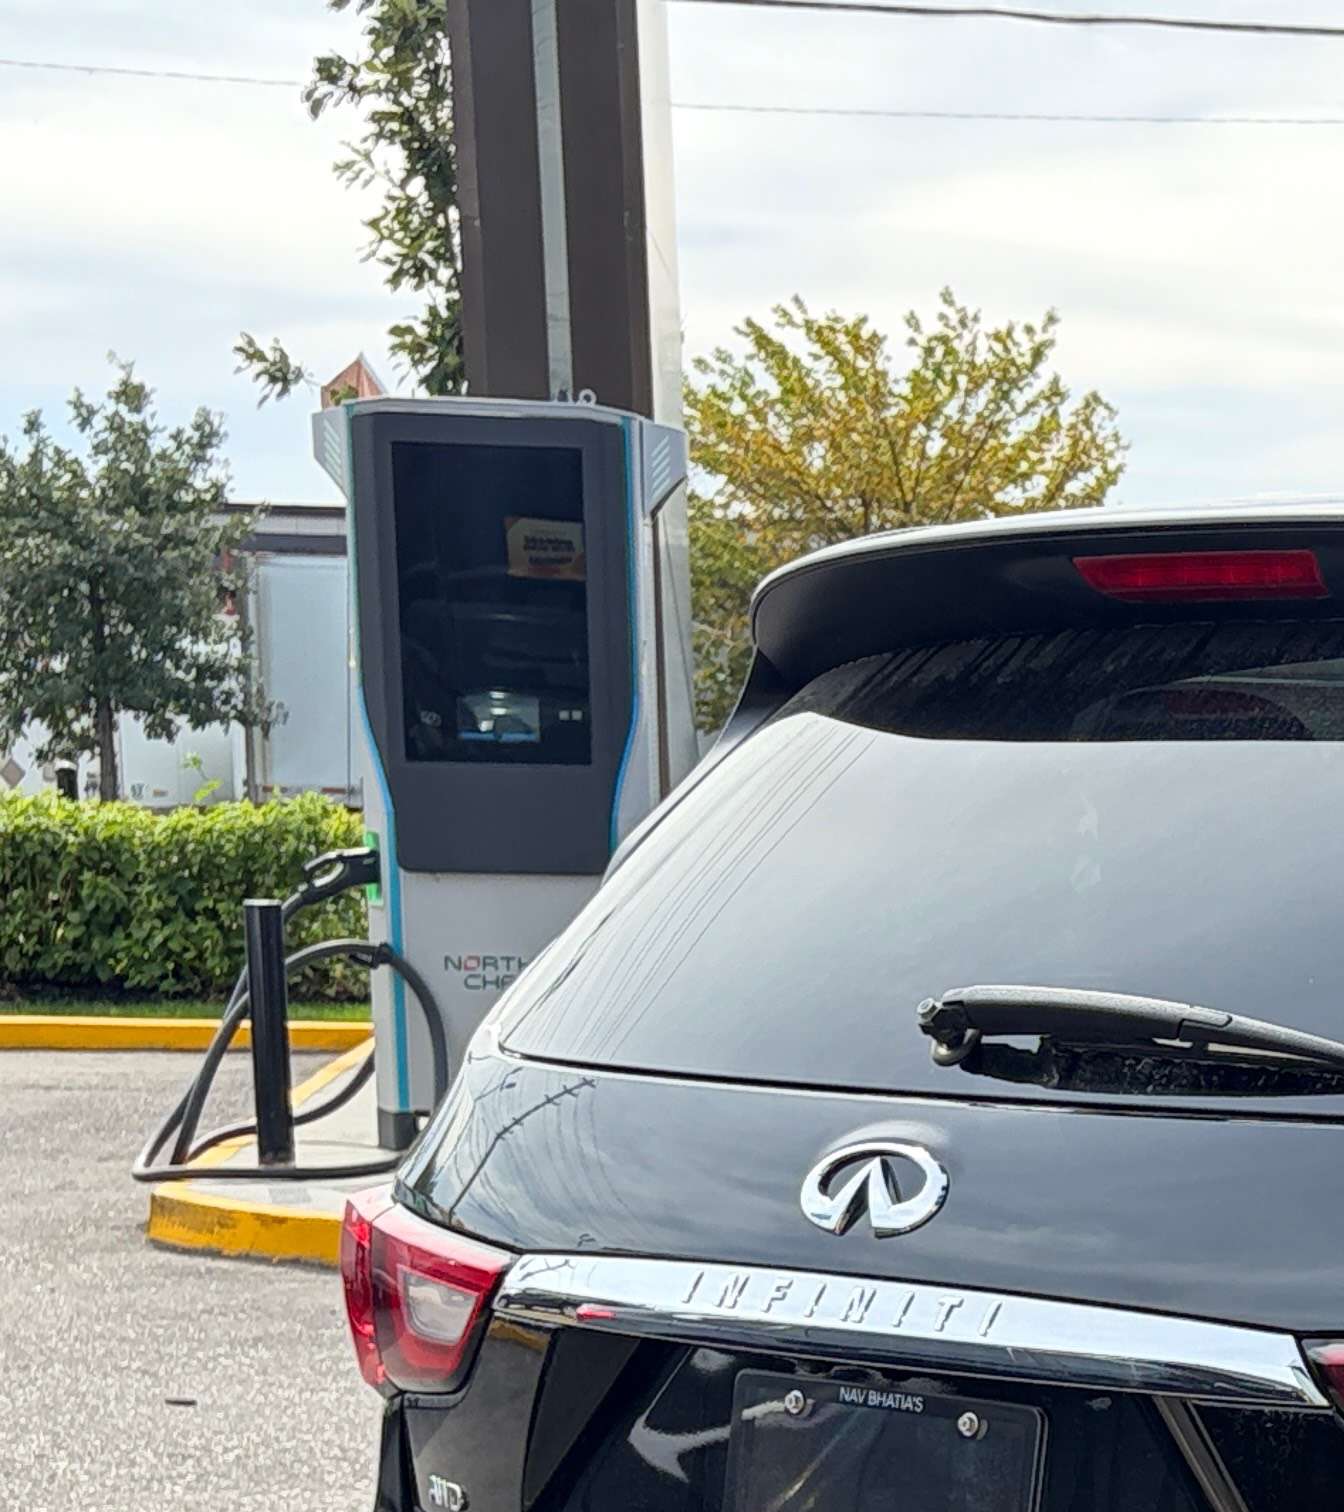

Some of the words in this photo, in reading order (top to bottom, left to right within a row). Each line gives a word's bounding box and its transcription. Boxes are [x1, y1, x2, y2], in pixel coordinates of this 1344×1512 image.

[682, 1271, 1002, 1337] INFINITI
[839, 1386, 867, 1404] NAV
[867, 1389, 924, 1413] BHATIA'S
